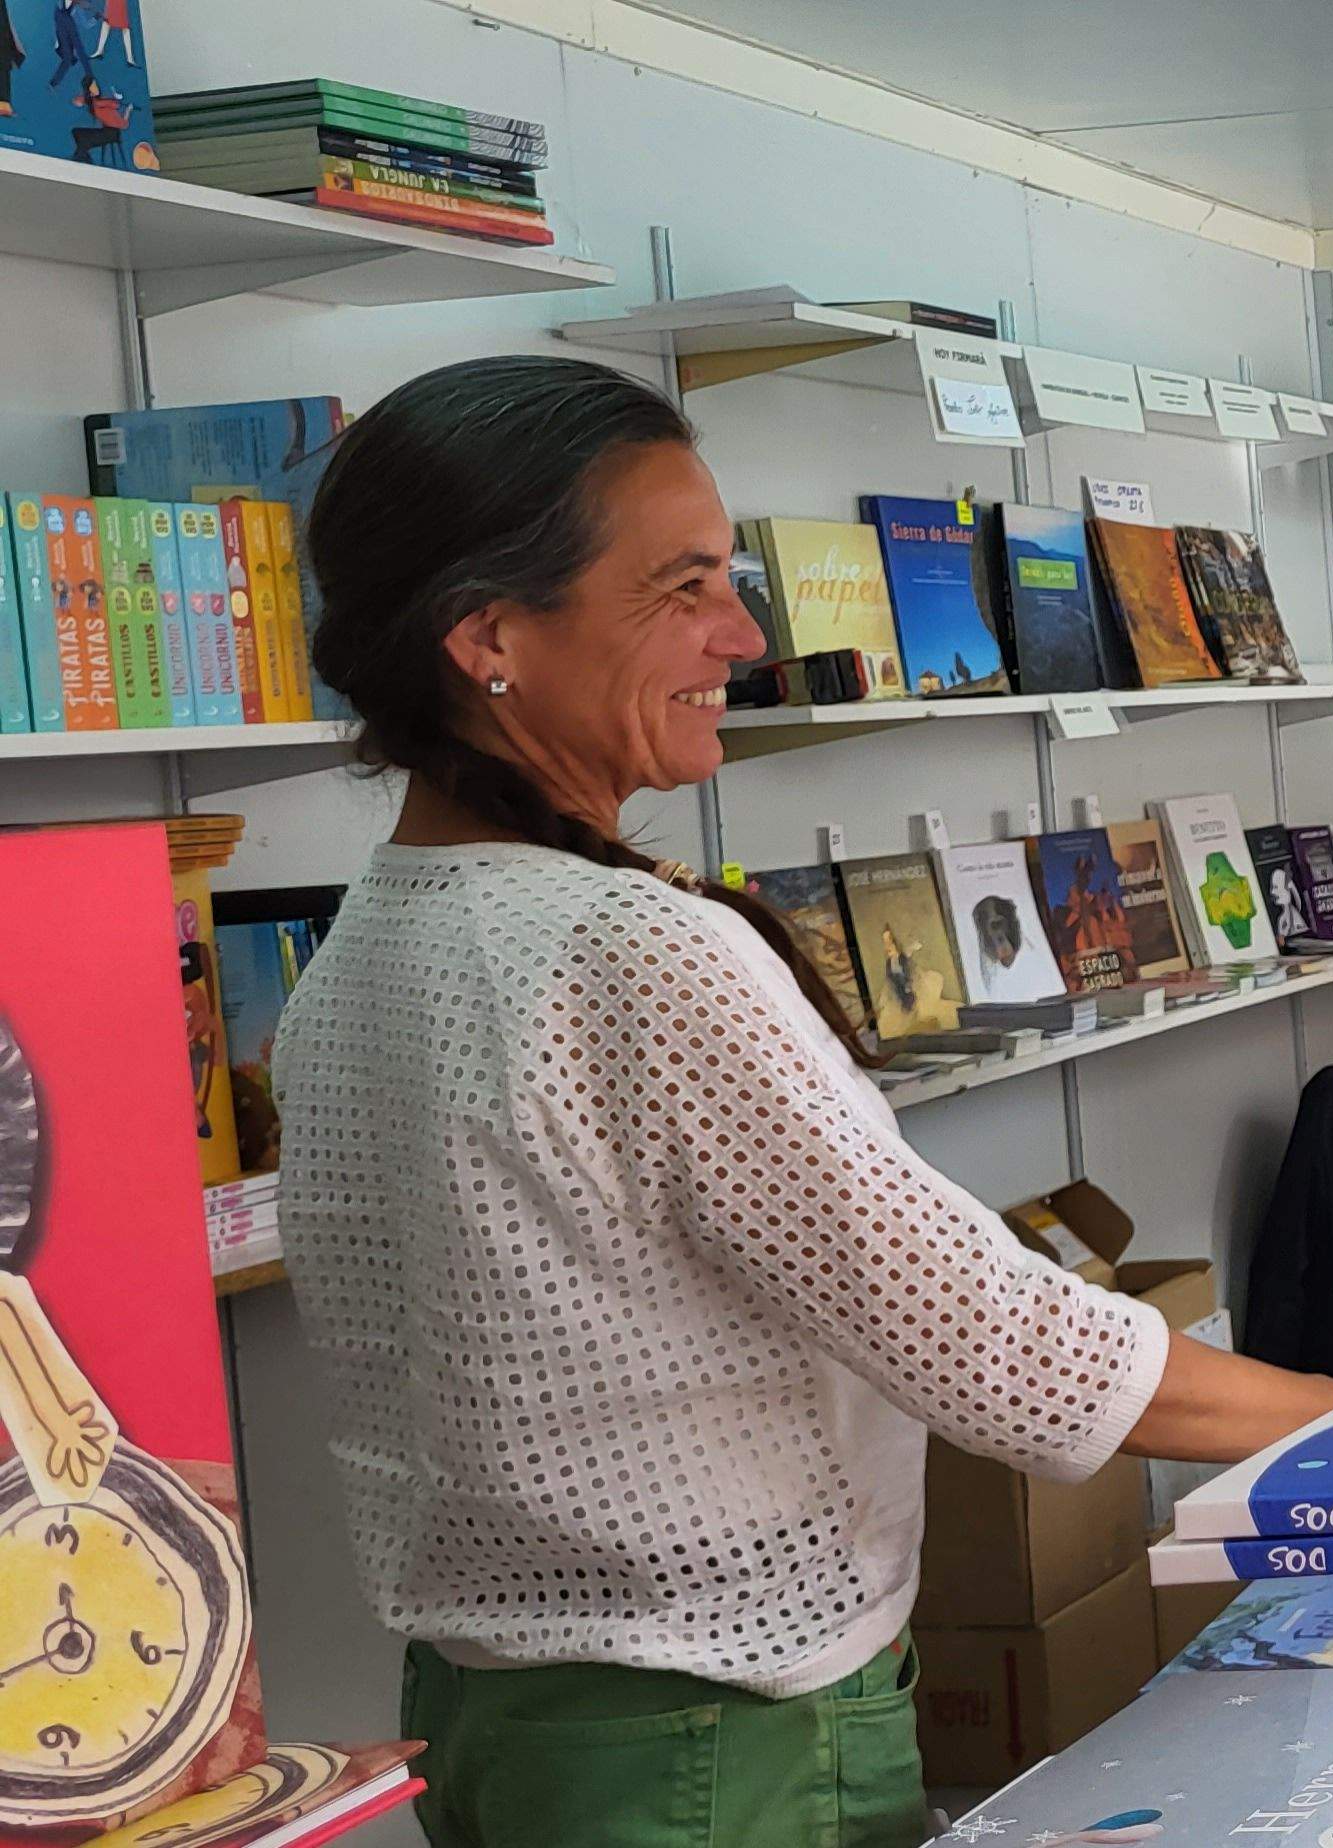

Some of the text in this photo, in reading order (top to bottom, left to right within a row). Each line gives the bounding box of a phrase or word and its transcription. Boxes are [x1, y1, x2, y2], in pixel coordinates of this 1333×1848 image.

[797, 544, 862, 582] sobre
[792, 569, 887, 625] papel
[58, 616, 89, 708] PIRATAS
[86, 616, 117, 708] PIRATAS
[1078, 954, 1121, 977] ESPACIO
[44, 1523, 79, 1554] 3
[1268, 1546, 1326, 1573] DOS
[130, 1630, 163, 1664] 6
